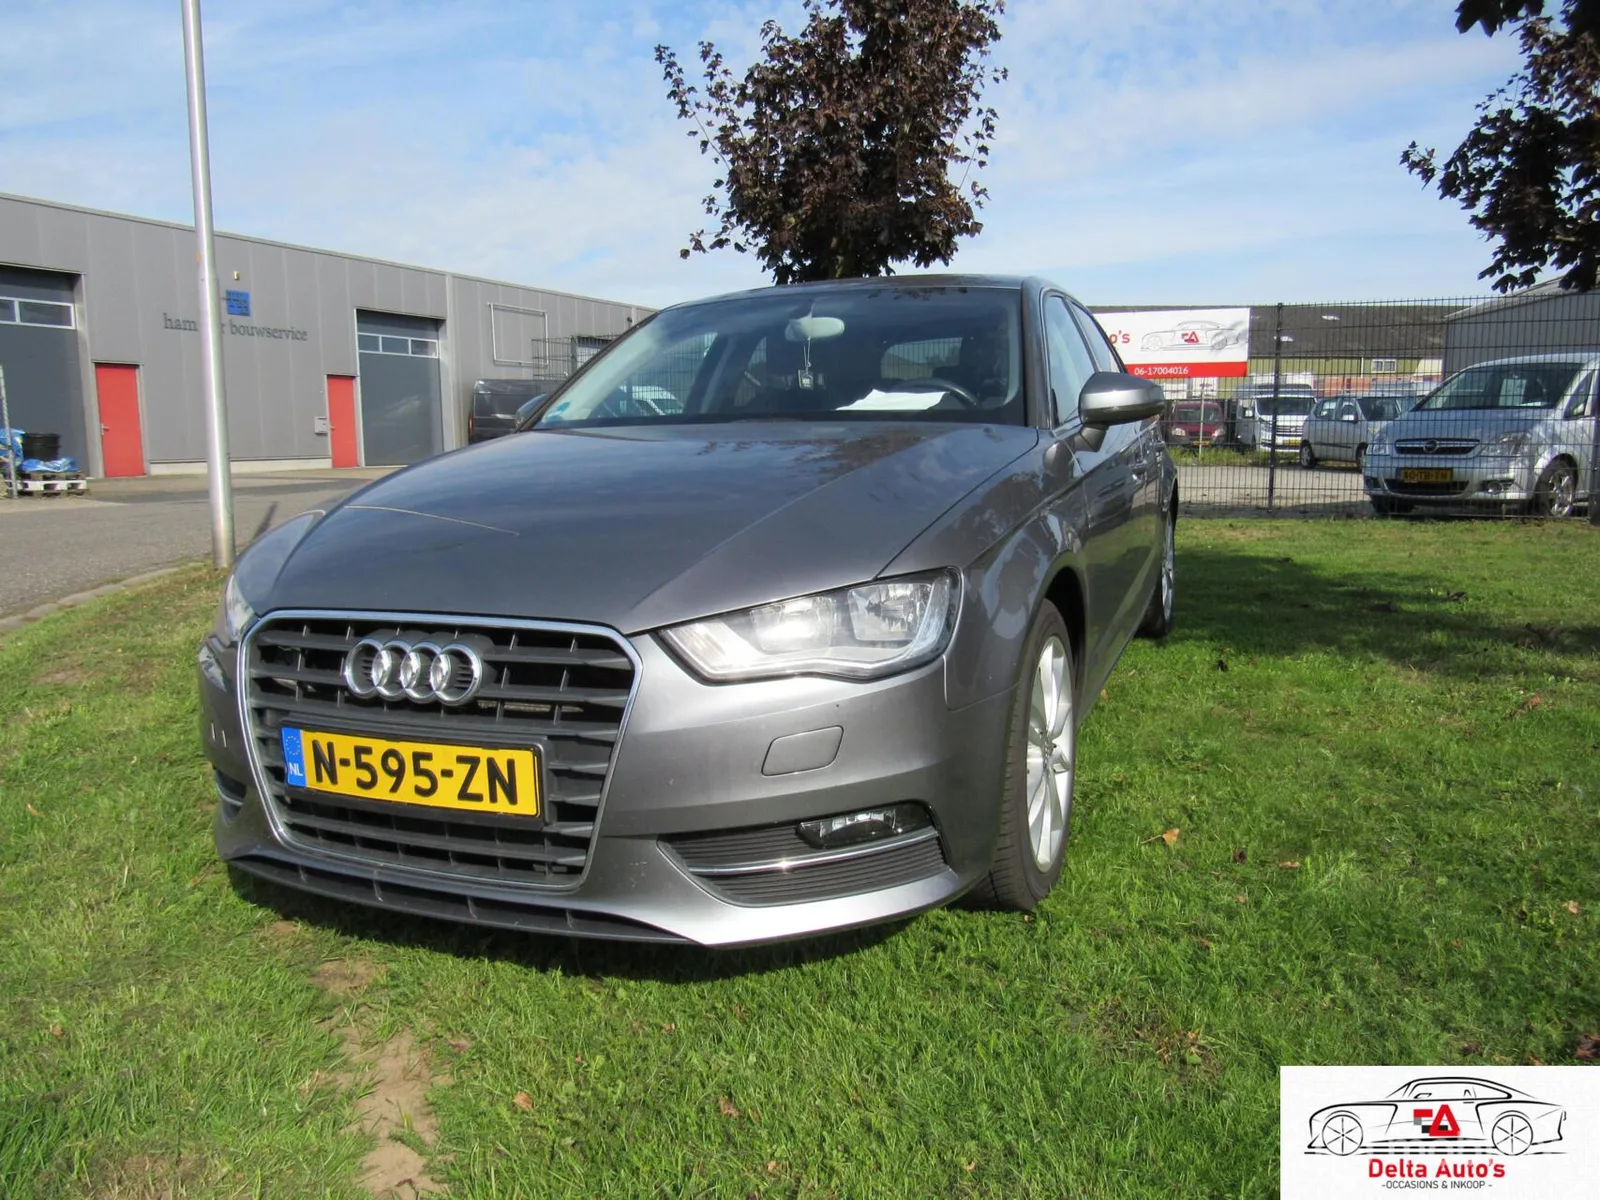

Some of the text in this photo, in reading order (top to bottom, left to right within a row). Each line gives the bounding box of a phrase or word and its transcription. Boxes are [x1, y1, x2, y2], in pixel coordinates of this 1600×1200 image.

[229, 320, 308, 342] bouwservice
[1134, 367, 1188, 376] 06-17004016
[289, 763, 303, 777] NL
[311, 739, 518, 806] N-595-ZN
